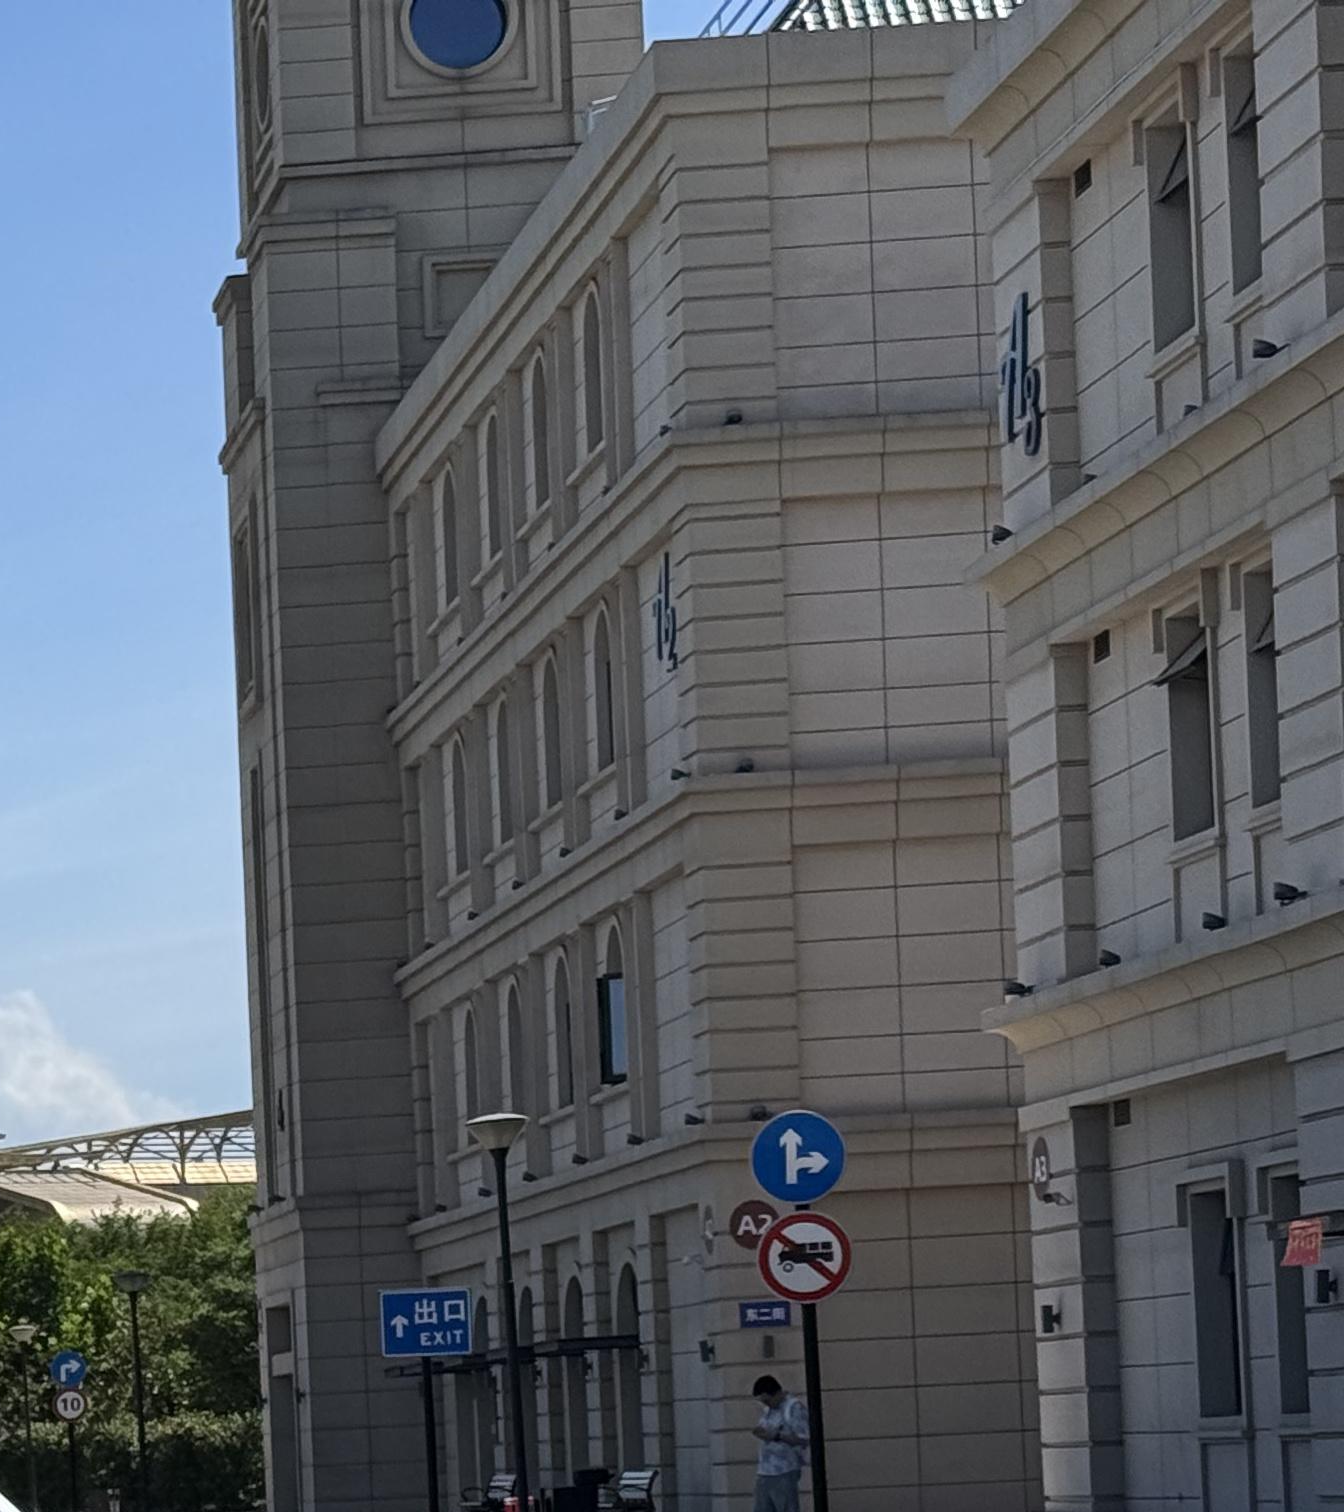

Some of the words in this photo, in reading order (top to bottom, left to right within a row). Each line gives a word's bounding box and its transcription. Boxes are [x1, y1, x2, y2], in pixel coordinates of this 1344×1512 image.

[999, 291, 1041, 457] A3
[1034, 1155, 1047, 1184] A3
[737, 1213, 772, 1237] A2
[414, 1298, 466, 1325] 出口
[420, 1329, 464, 1346] EXIT
[61, 1398, 81, 1412] 10
